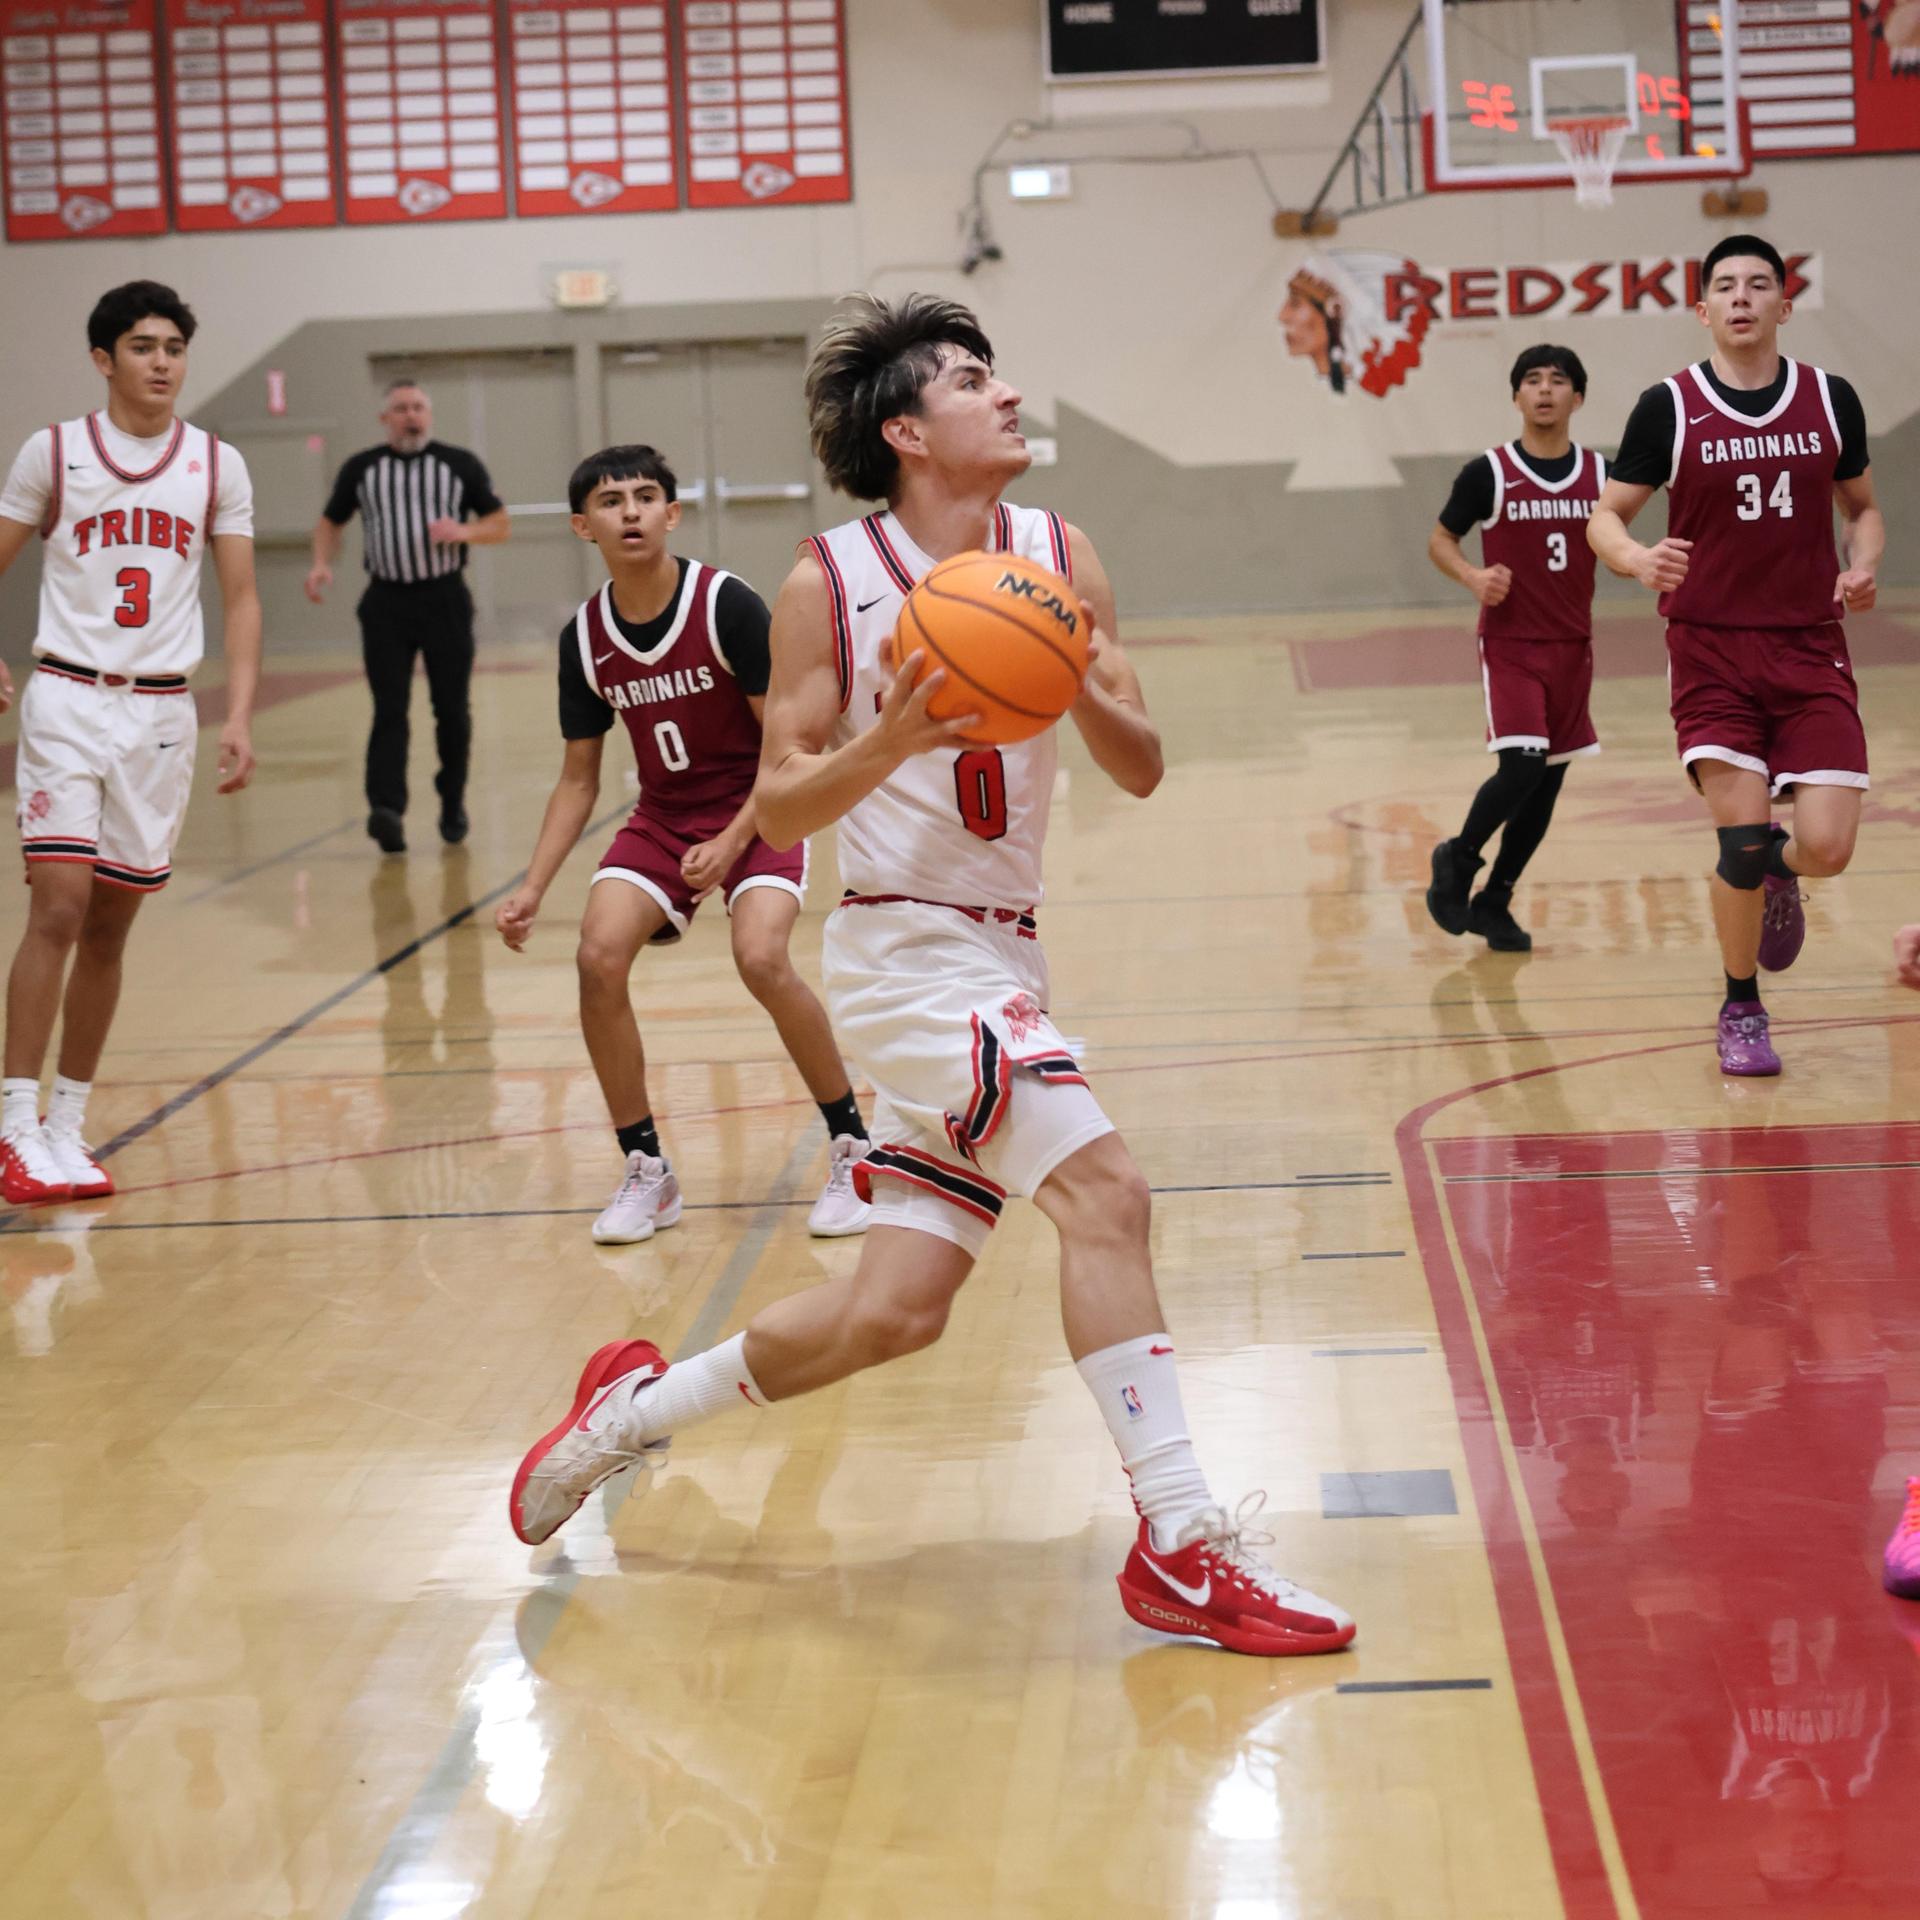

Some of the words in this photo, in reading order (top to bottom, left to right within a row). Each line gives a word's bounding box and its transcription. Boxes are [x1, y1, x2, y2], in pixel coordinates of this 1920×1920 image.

[1063, 3, 1114, 24] HOME
[1384, 252, 1811, 322] REDSKIS
[1700, 431, 1822, 465] CARDINALS
[1736, 470, 1793, 521] 34
[73, 507, 195, 561] TRIBE
[1547, 532, 1567, 571] 3
[114, 567, 152, 628] 3
[996, 570, 1077, 636] NCAA
[604, 665, 715, 710] CARDINALS
[653, 720, 691, 772] 0
[953, 748, 1007, 842] 0
